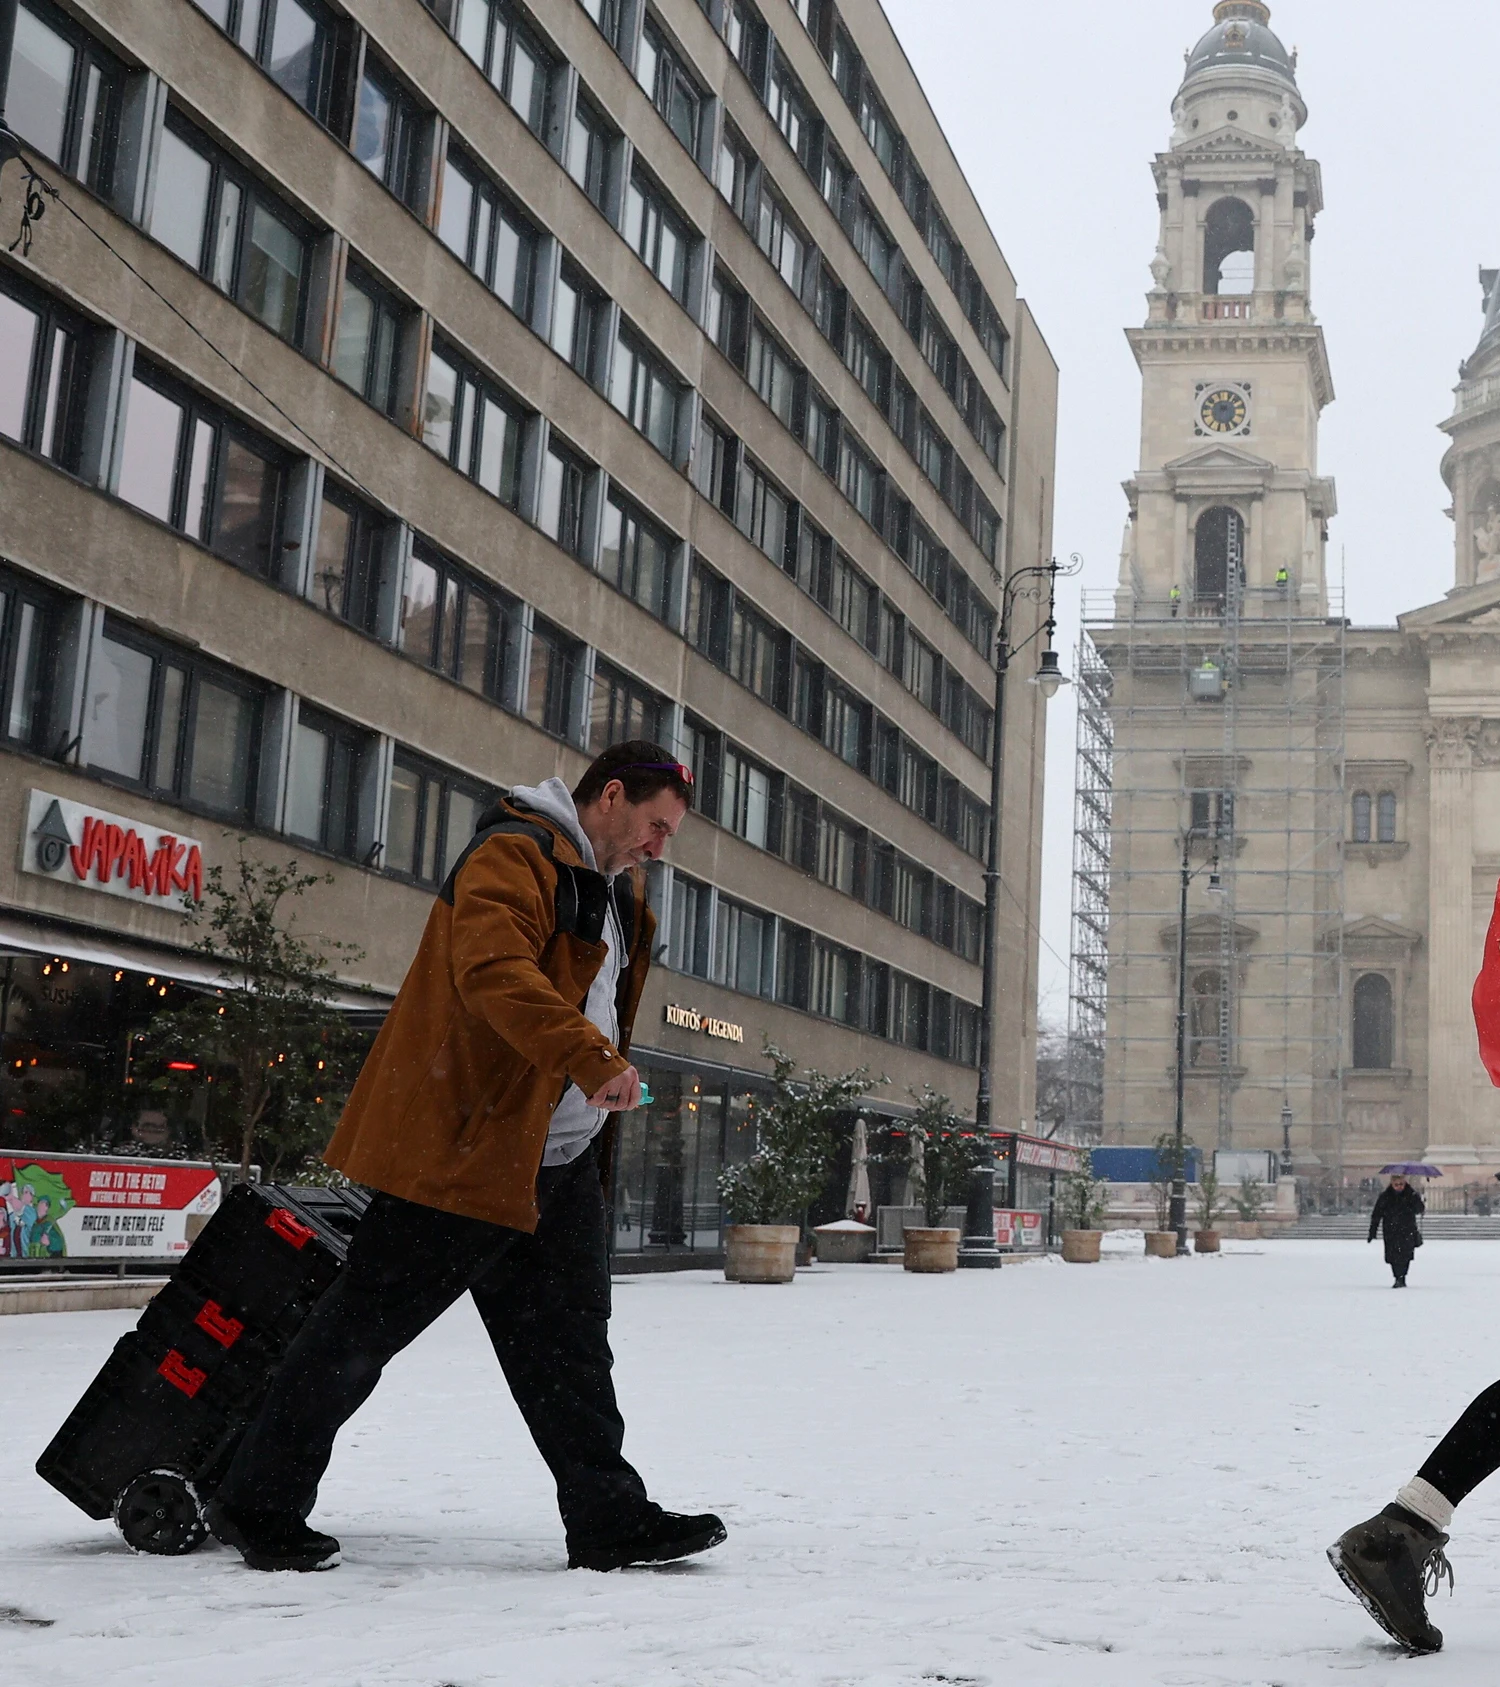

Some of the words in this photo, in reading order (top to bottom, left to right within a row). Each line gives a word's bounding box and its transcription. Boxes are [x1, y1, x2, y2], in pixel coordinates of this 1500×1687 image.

[708, 1018, 743, 1043] LEGENDA
[82, 1215, 110, 1231] ARCCAL
[113, 1216, 120, 1231] A
[148, 1214, 165, 1231] FELÉ
